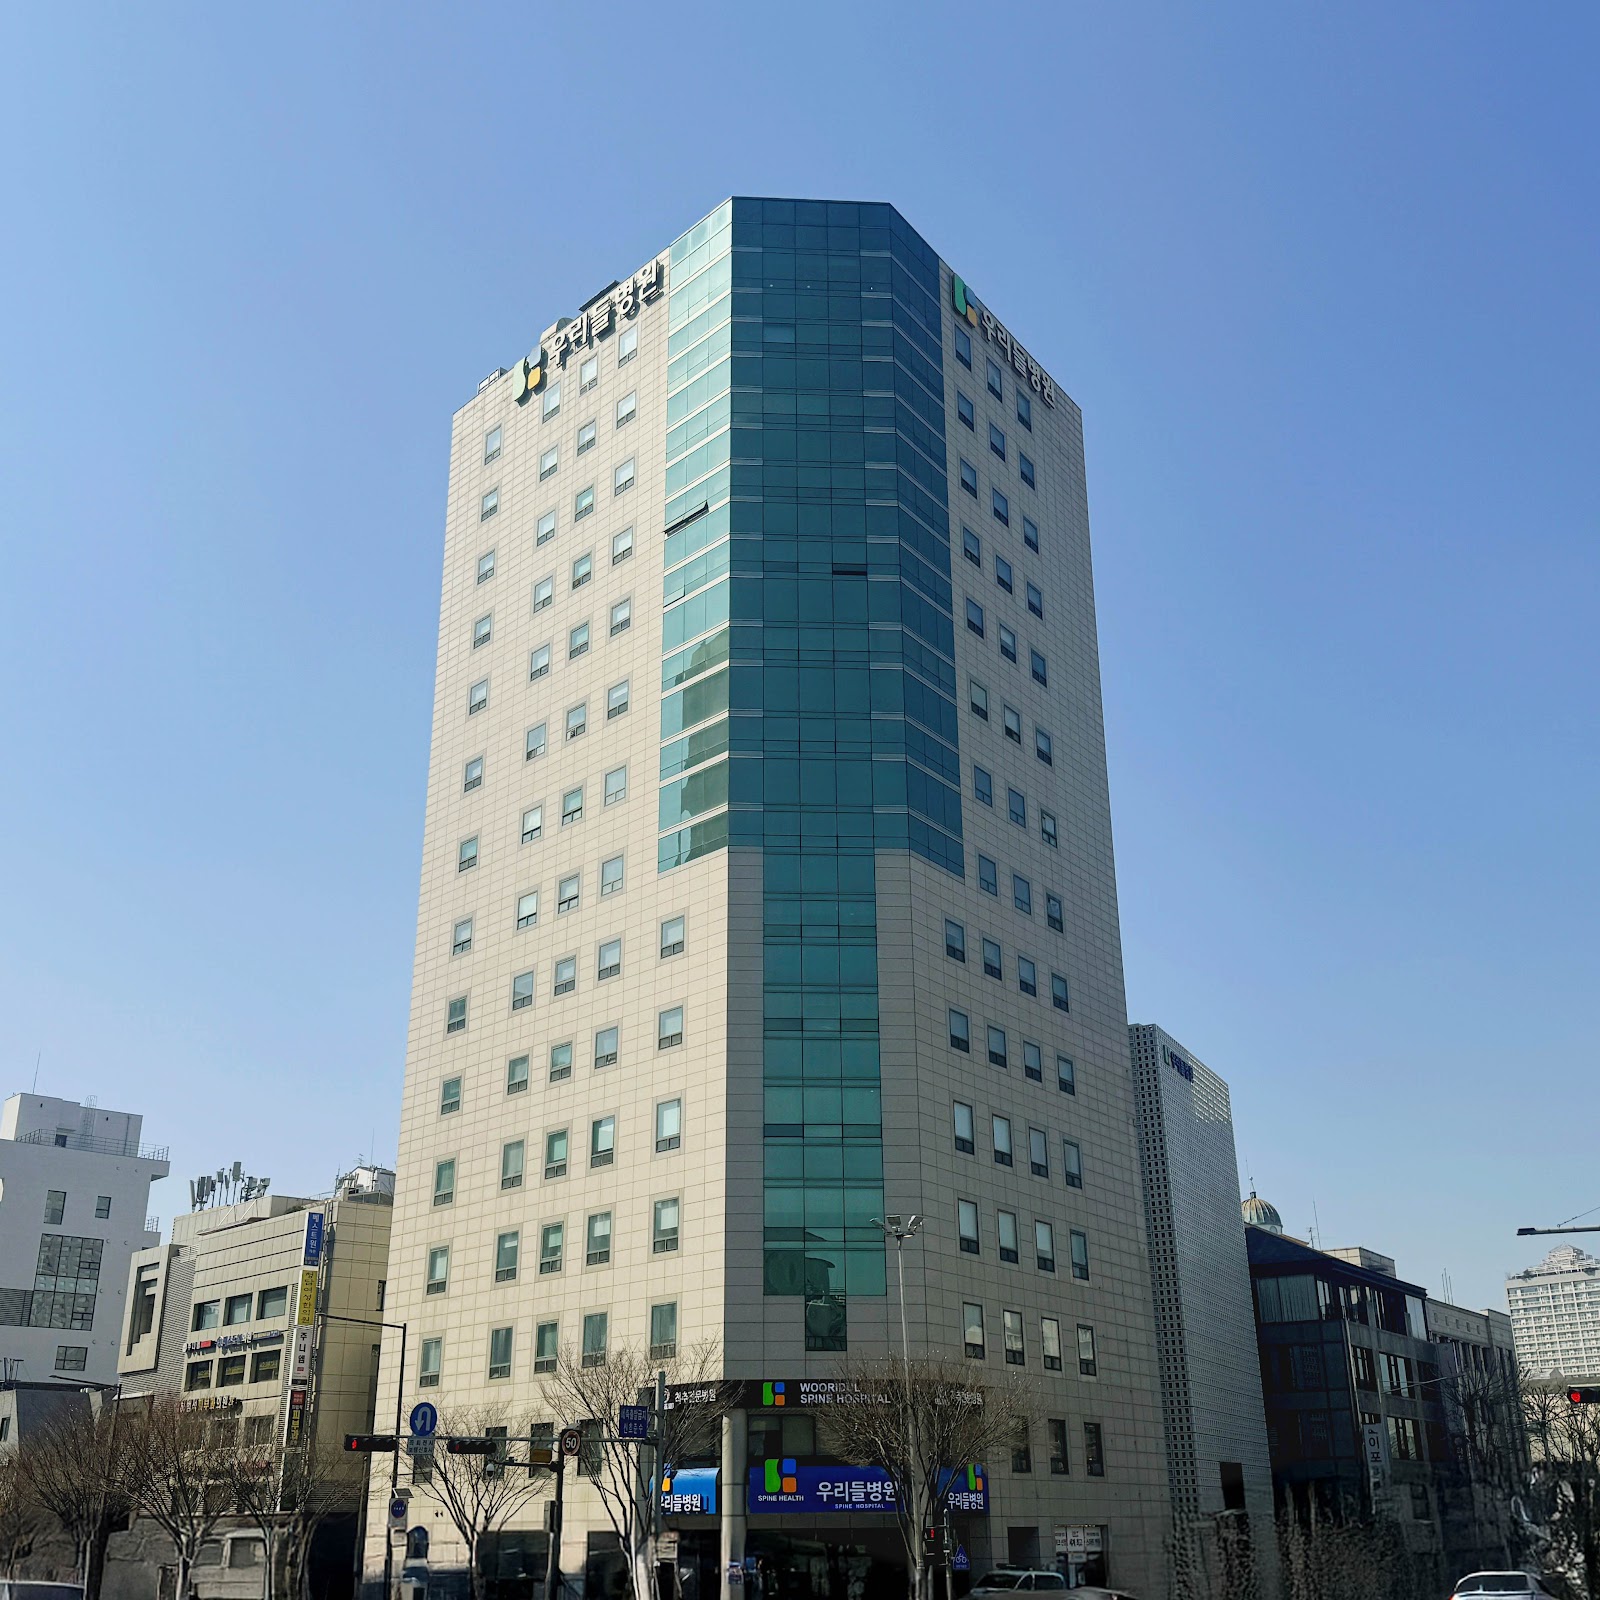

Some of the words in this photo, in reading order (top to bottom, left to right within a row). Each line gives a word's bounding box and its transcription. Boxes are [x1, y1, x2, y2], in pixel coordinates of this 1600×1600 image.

[549, 258, 660, 367] 우리들병원
[981, 310, 1055, 409] 우리들병원
[800, 1382, 860, 1393] WOORIDL
[800, 1393, 832, 1404] SPINE
[623, 1422, 643, 1434] 신호준수
[565, 1437, 577, 1449] 50
[816, 1481, 898, 1502] 우리들병원
[948, 1492, 984, 1510] 우리들병원
